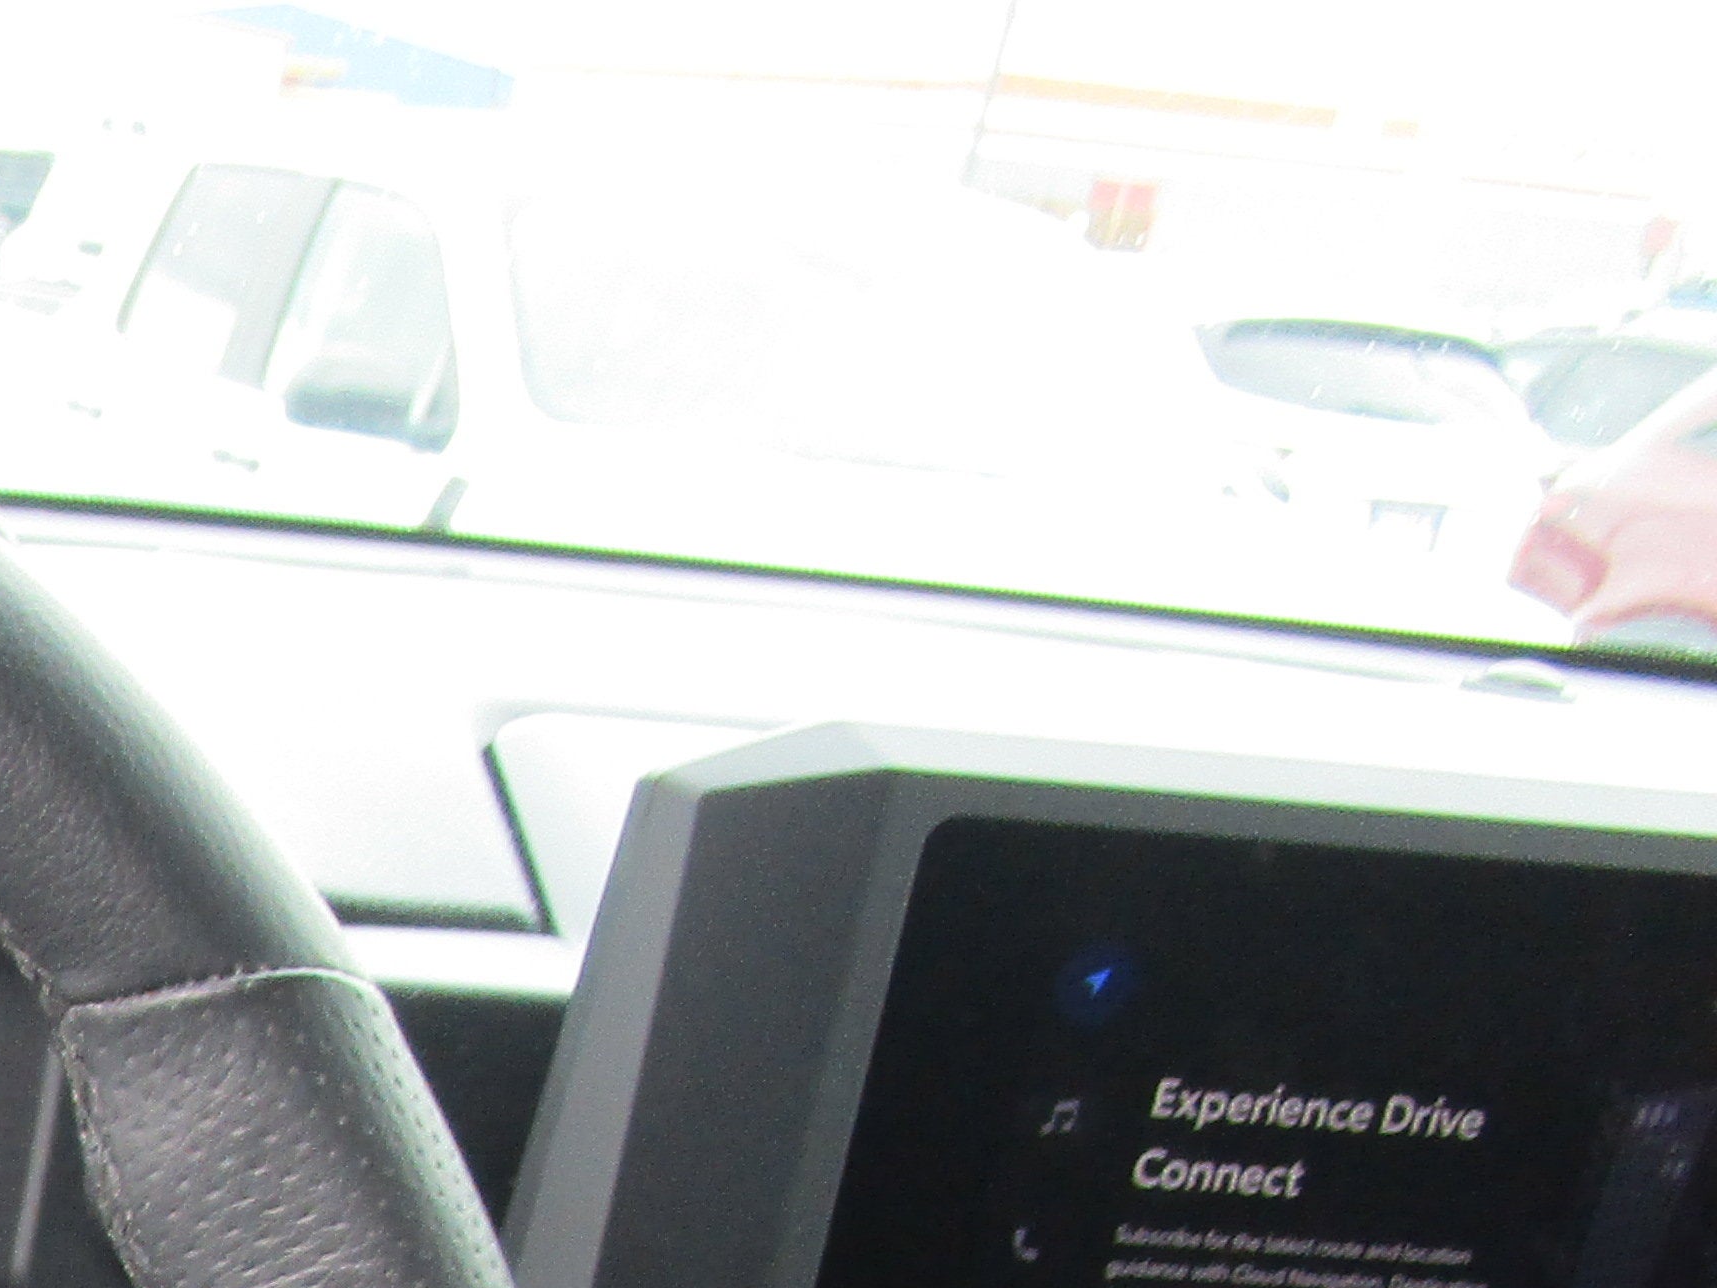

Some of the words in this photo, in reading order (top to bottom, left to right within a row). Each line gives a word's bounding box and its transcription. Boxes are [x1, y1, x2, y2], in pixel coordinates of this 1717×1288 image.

[1150, 1076, 1374, 1132] Experience
[1379, 1093, 1486, 1141] Drive
[1131, 1146, 1306, 1199] Connect
